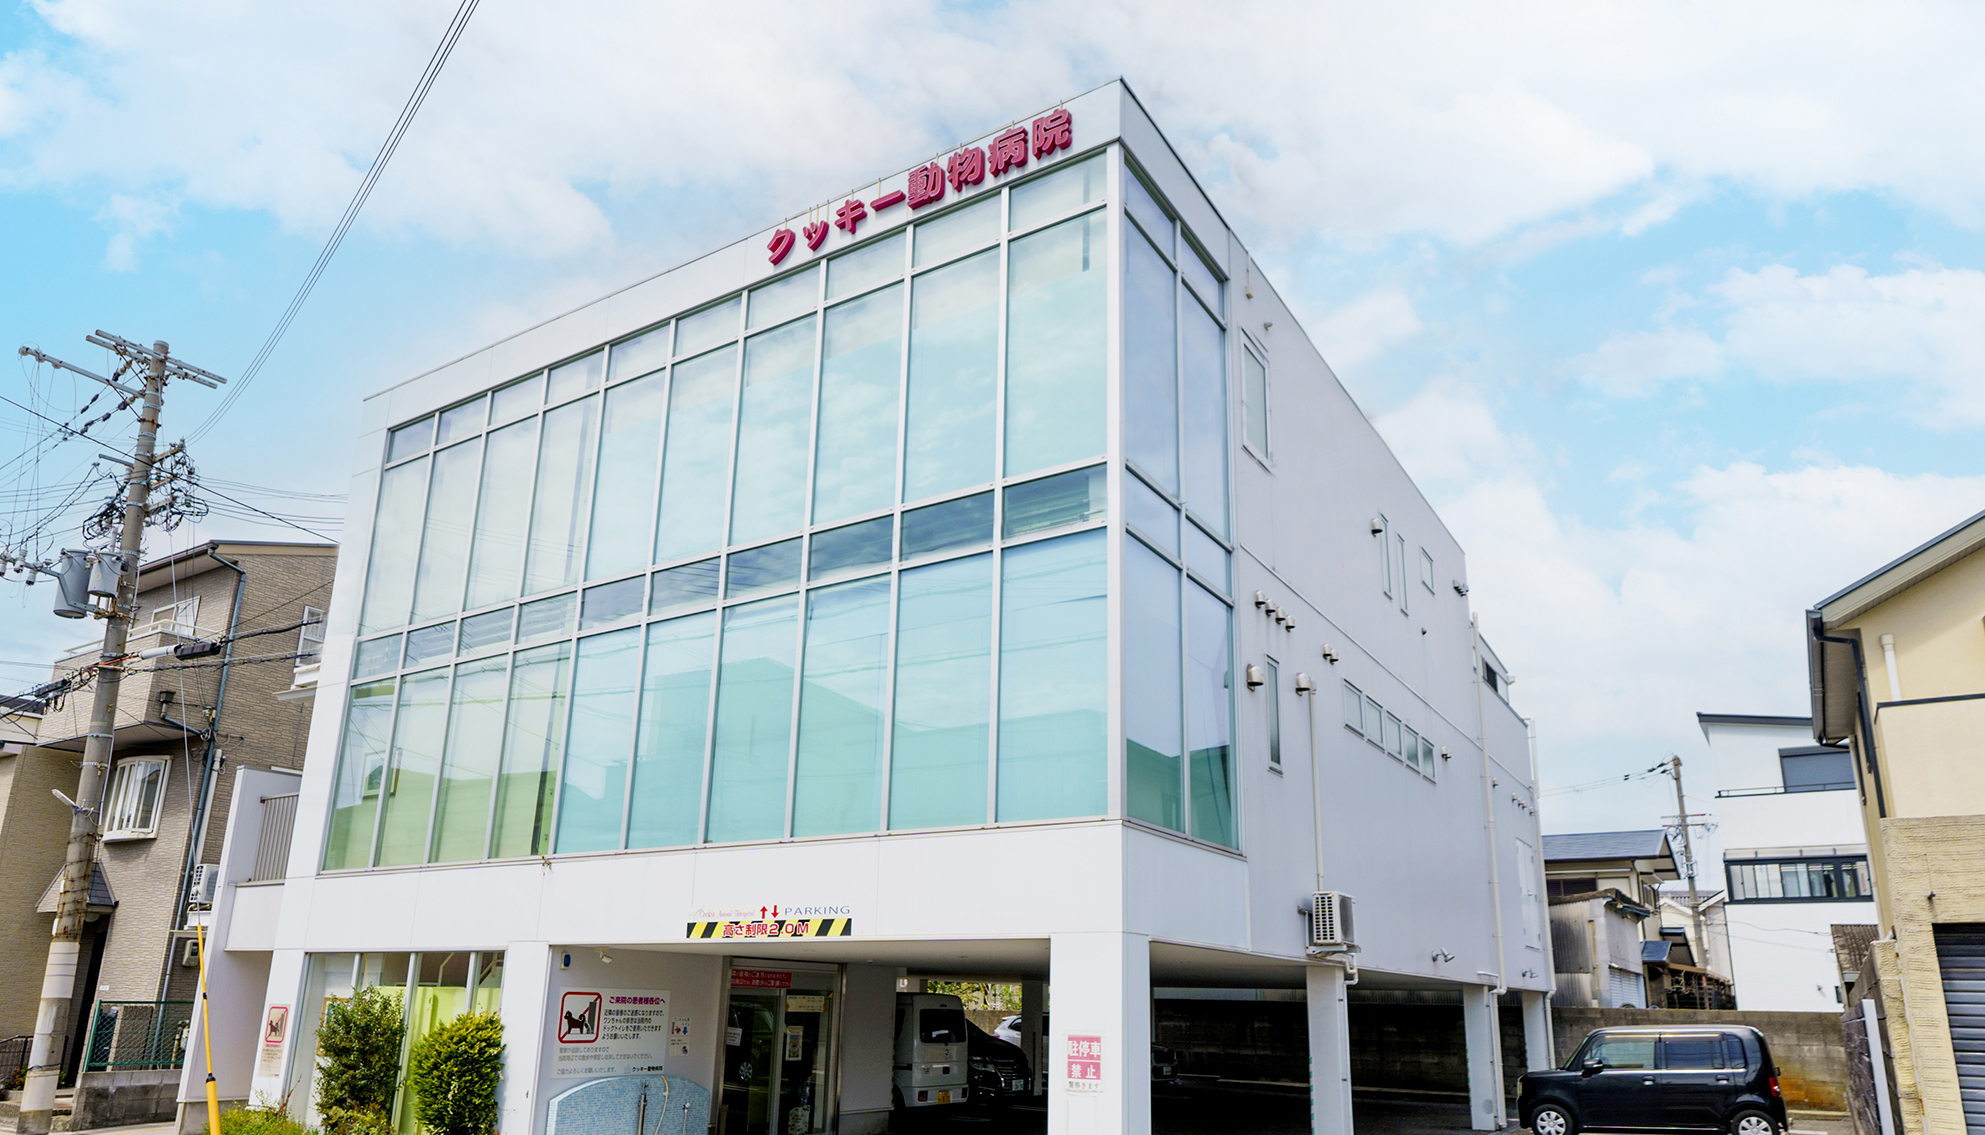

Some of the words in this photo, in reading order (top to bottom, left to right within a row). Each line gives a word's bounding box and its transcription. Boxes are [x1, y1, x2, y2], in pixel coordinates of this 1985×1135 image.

[767, 108, 1073, 266] クッキー動物病院
[784, 905, 851, 916] PARKING
[722, 922, 810, 937] 高さ制限2.0M
[608, 996, 666, 1005] ご来院の患者様各位へ
[1067, 1040, 1102, 1058] 駐停車
[632, 1065, 663, 1073] クッキー動物病院
[1071, 1063, 1097, 1079] 禁止
